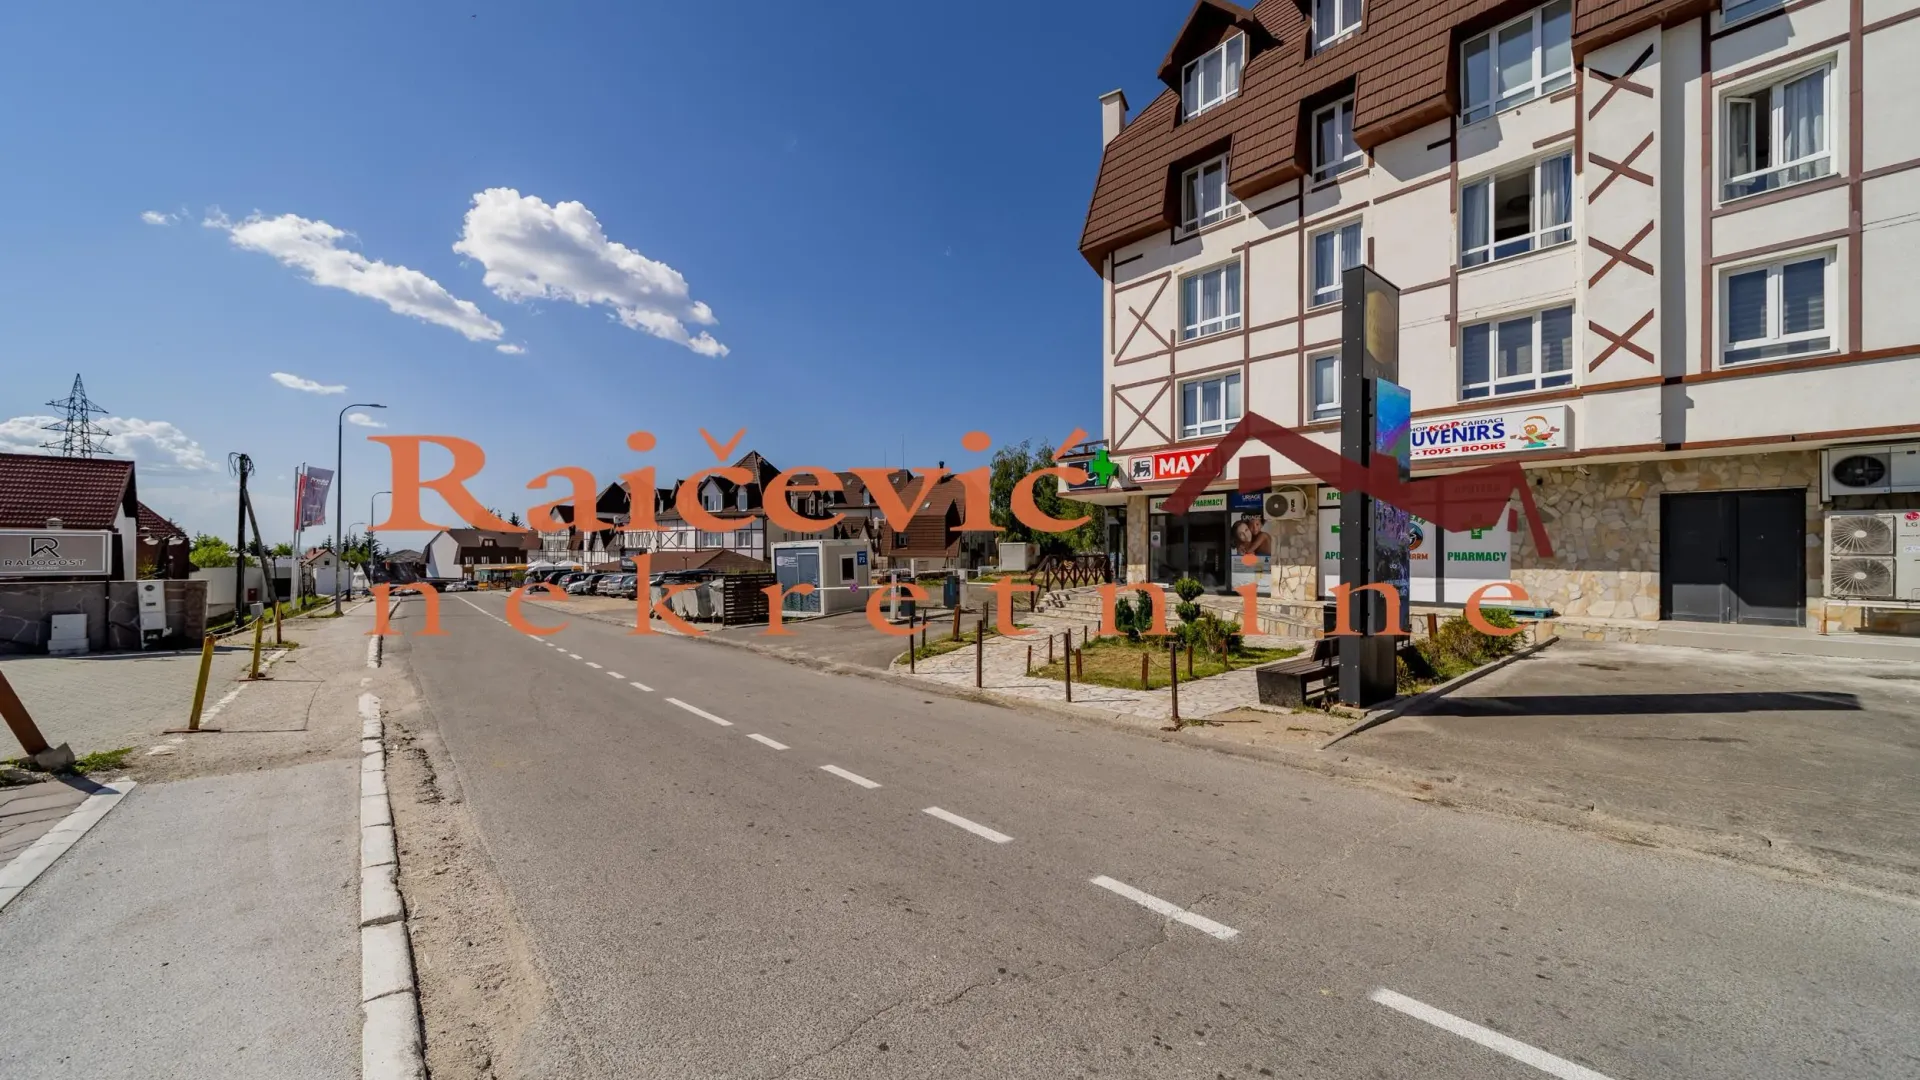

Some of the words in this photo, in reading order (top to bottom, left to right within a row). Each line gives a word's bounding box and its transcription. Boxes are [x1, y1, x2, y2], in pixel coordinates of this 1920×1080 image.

[1429, 421, 1460, 432] KOP
[1411, 423, 1505, 446] UVENIRS
[1422, 447, 1451, 456] TOYS
[1461, 443, 1506, 452] BOOKS
[1158, 453, 1212, 475] MAX
[1193, 498, 1224, 507] PHARMACY
[1447, 551, 1507, 562] PHARMACY
